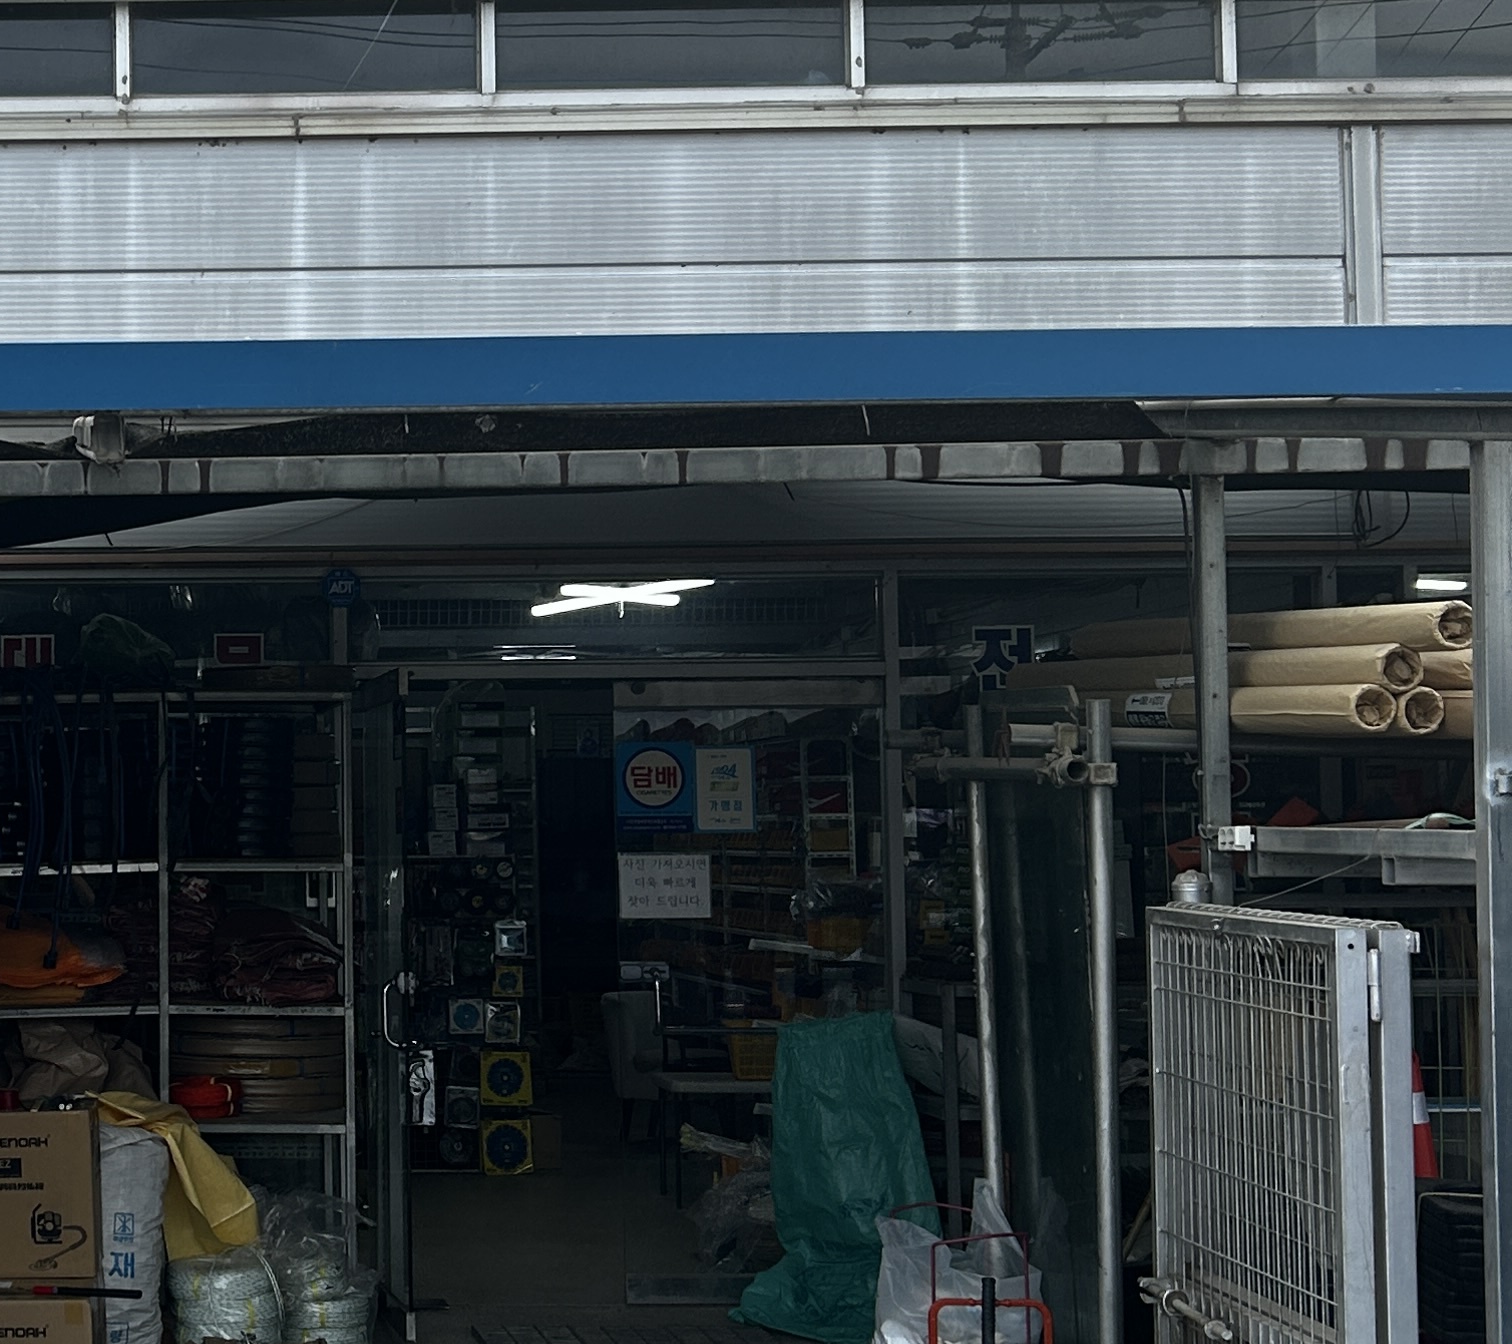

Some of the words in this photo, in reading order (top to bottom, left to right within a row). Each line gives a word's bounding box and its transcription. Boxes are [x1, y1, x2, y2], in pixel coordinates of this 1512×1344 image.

[328, 580, 355, 594] ADT
[631, 765, 678, 788] 담배
[623, 858, 645, 871] 사진
